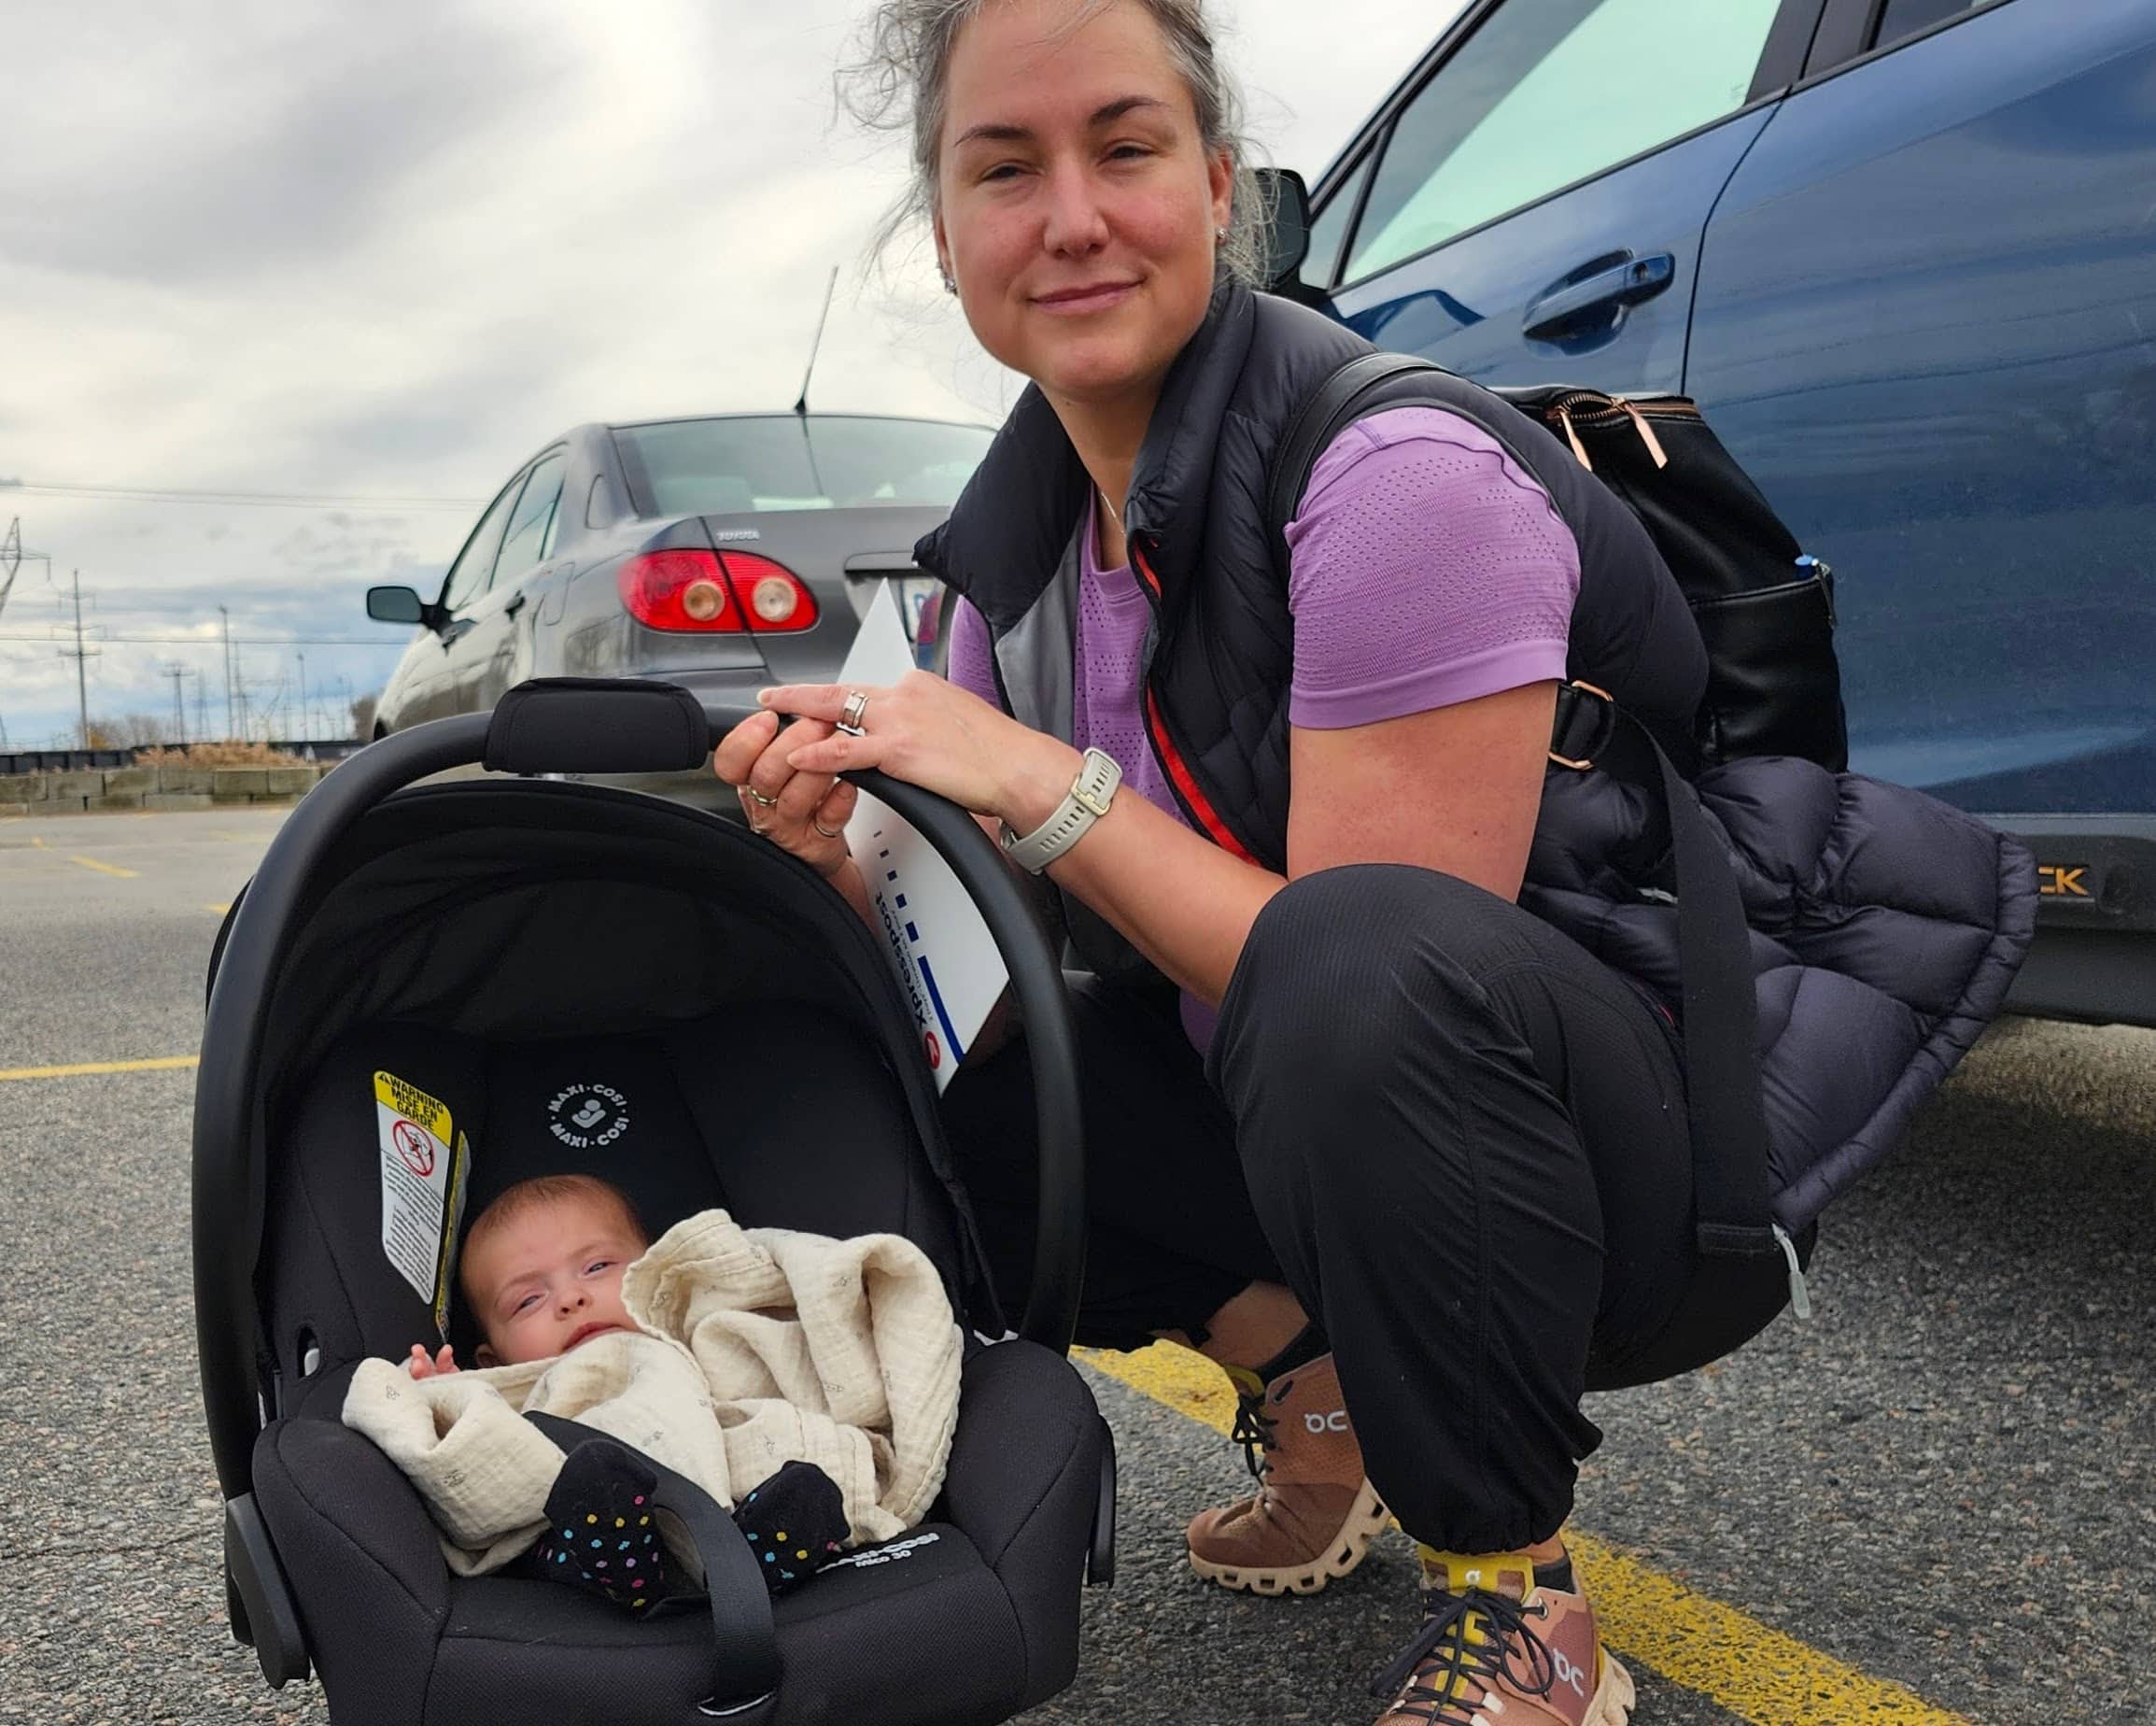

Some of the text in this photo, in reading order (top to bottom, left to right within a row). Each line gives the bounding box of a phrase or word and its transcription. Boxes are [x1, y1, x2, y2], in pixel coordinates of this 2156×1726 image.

[389, 1075, 444, 1113] WARNING
[390, 1085, 438, 1122] MISE EN
[397, 1101, 433, 1130] GARDE
